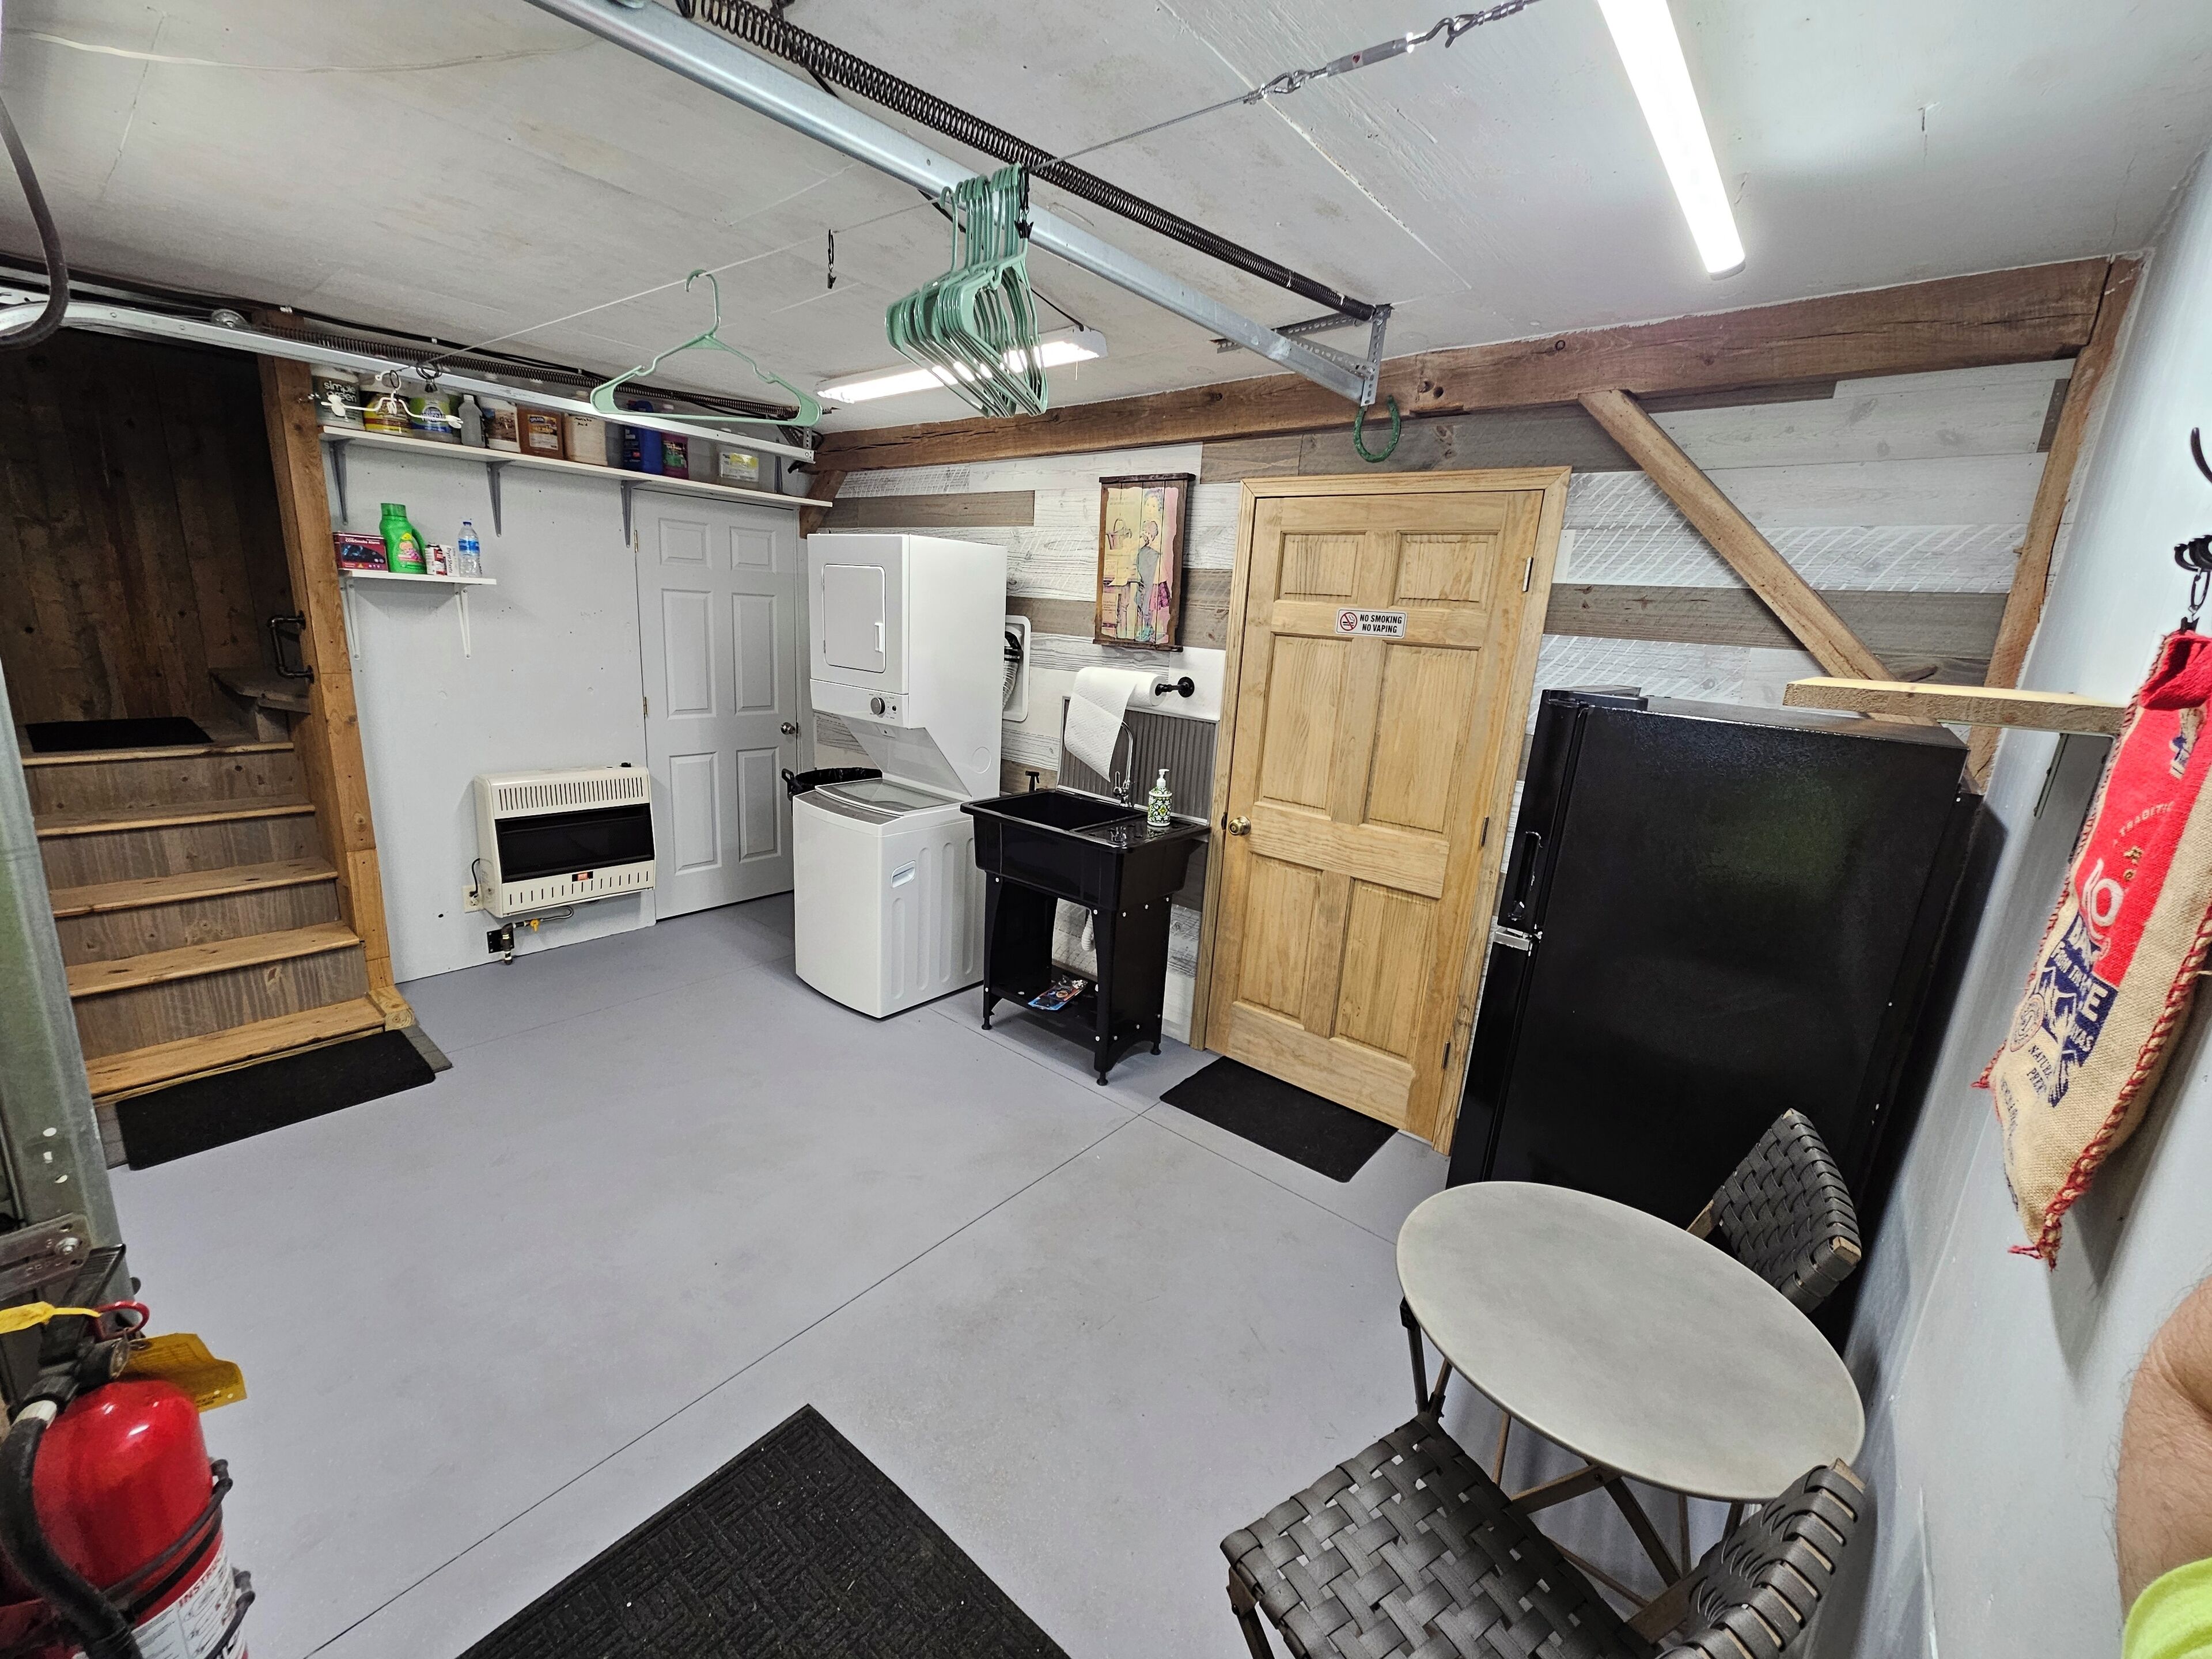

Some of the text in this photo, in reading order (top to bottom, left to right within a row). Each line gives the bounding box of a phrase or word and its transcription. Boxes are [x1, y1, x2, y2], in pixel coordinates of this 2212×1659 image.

[323, 380, 356, 394] simple
[1359, 614, 1402, 624] NO SMOKING
[1362, 623, 1397, 633] NO VAPING
